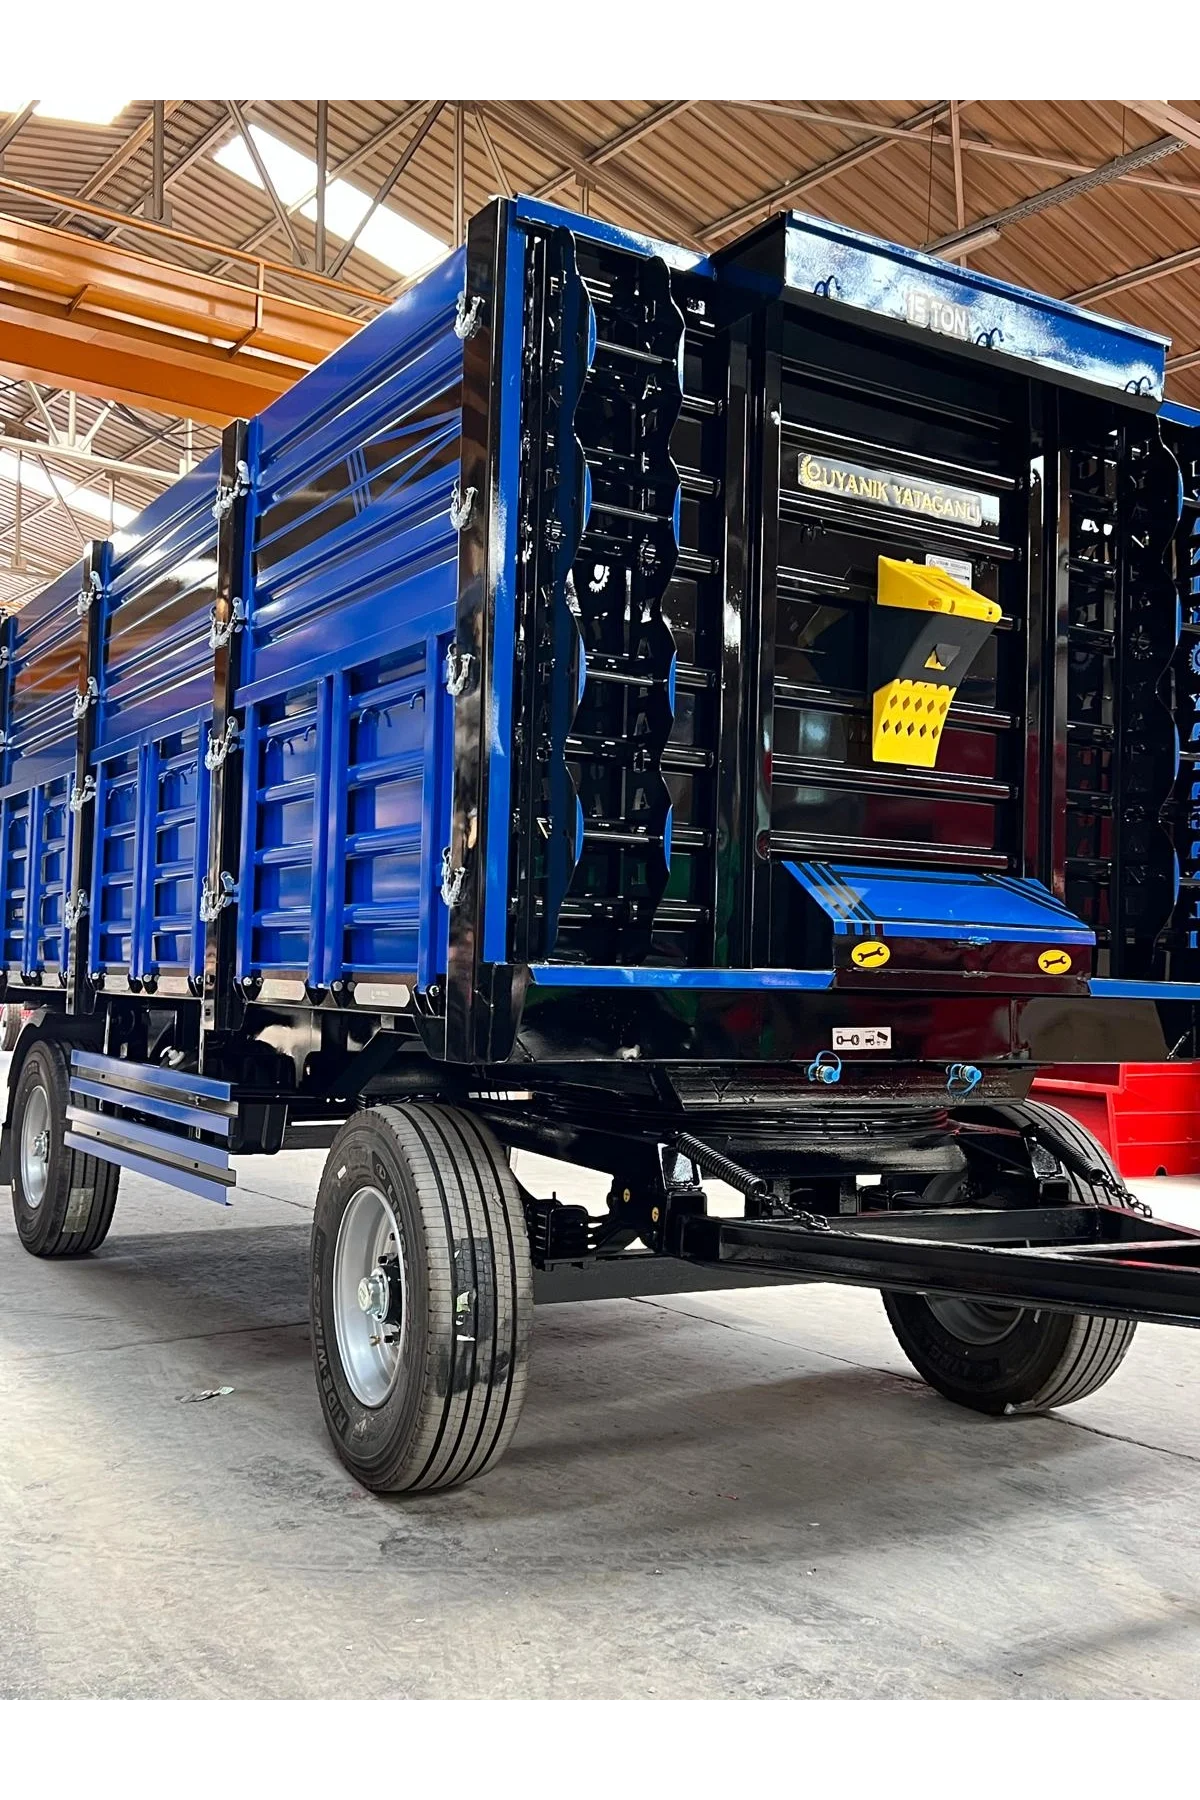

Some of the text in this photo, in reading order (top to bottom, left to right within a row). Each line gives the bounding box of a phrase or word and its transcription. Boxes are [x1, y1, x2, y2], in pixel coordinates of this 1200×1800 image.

[906, 291, 969, 338] 15 TON
[821, 466, 980, 522] UYANIK YATAĞANLI
